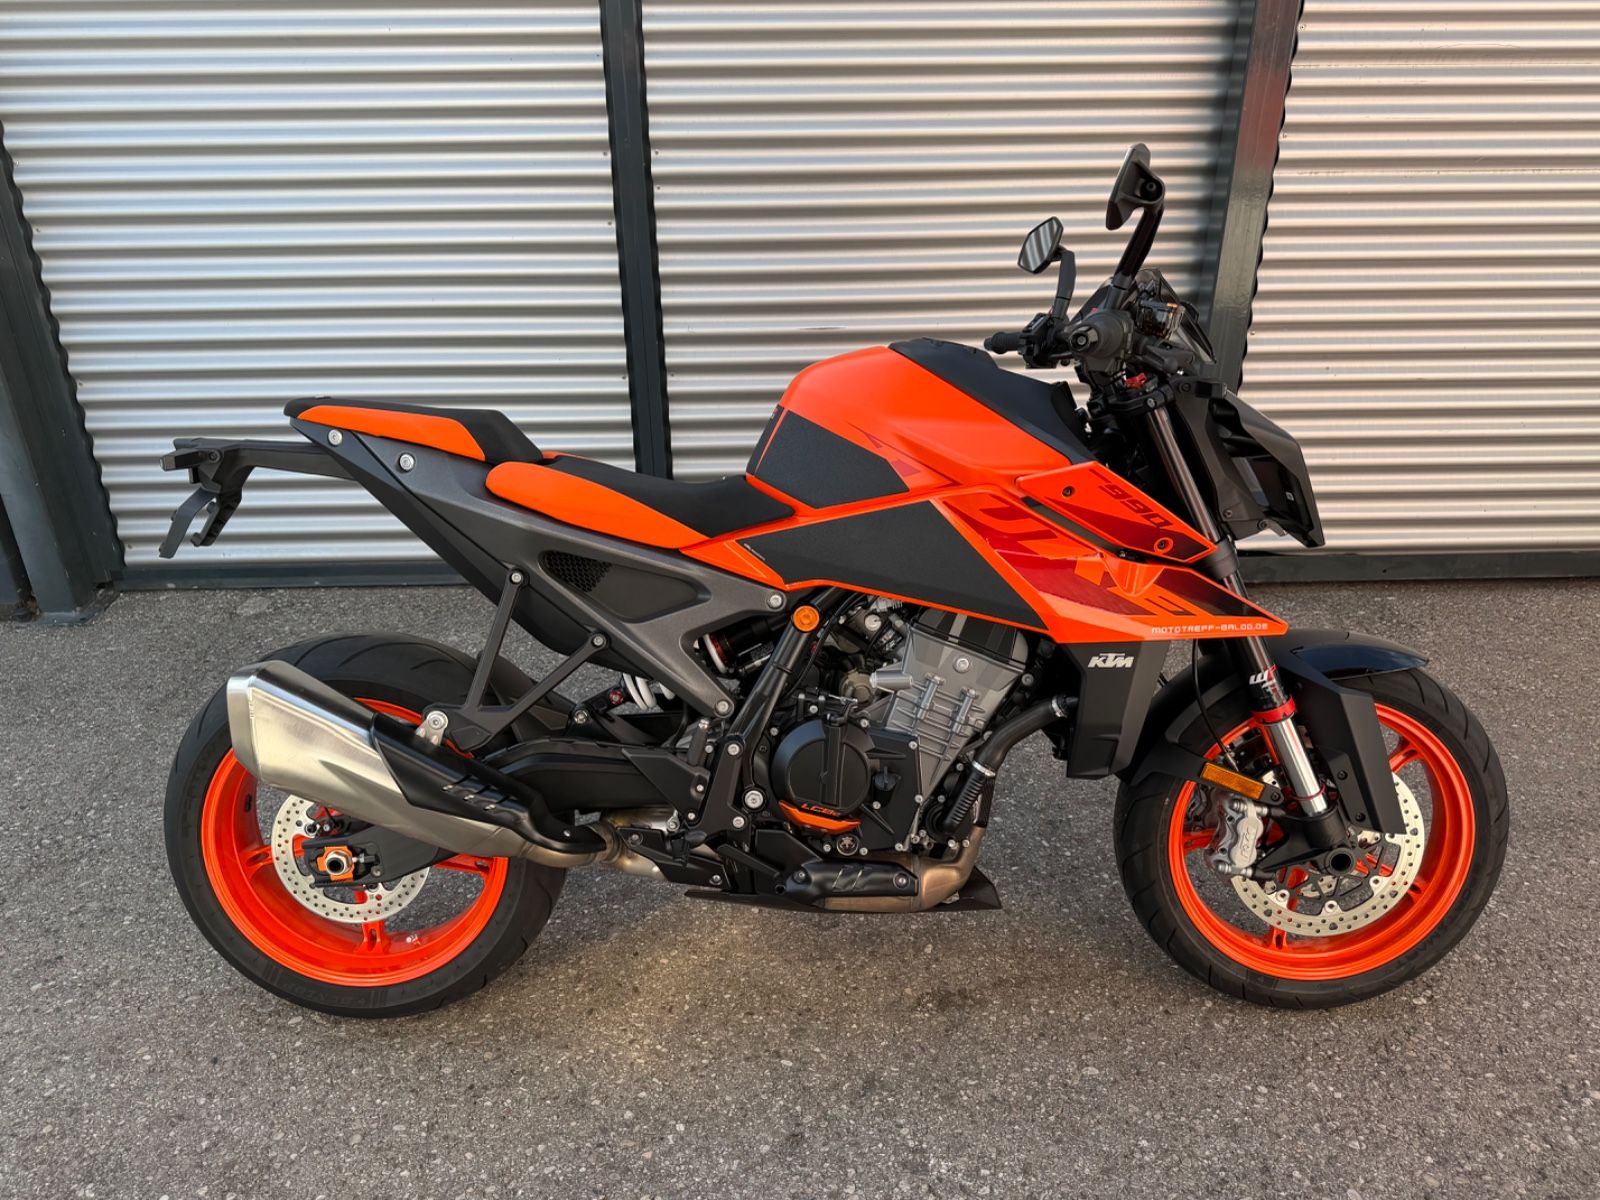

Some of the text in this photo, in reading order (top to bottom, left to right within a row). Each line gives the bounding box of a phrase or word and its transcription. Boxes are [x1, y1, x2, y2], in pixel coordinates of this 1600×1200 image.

[1098, 484, 1174, 528] 990
[1151, 622, 1269, 634] MOTOTREFF-BALOG.DE
[1087, 653, 1134, 668] KTM
